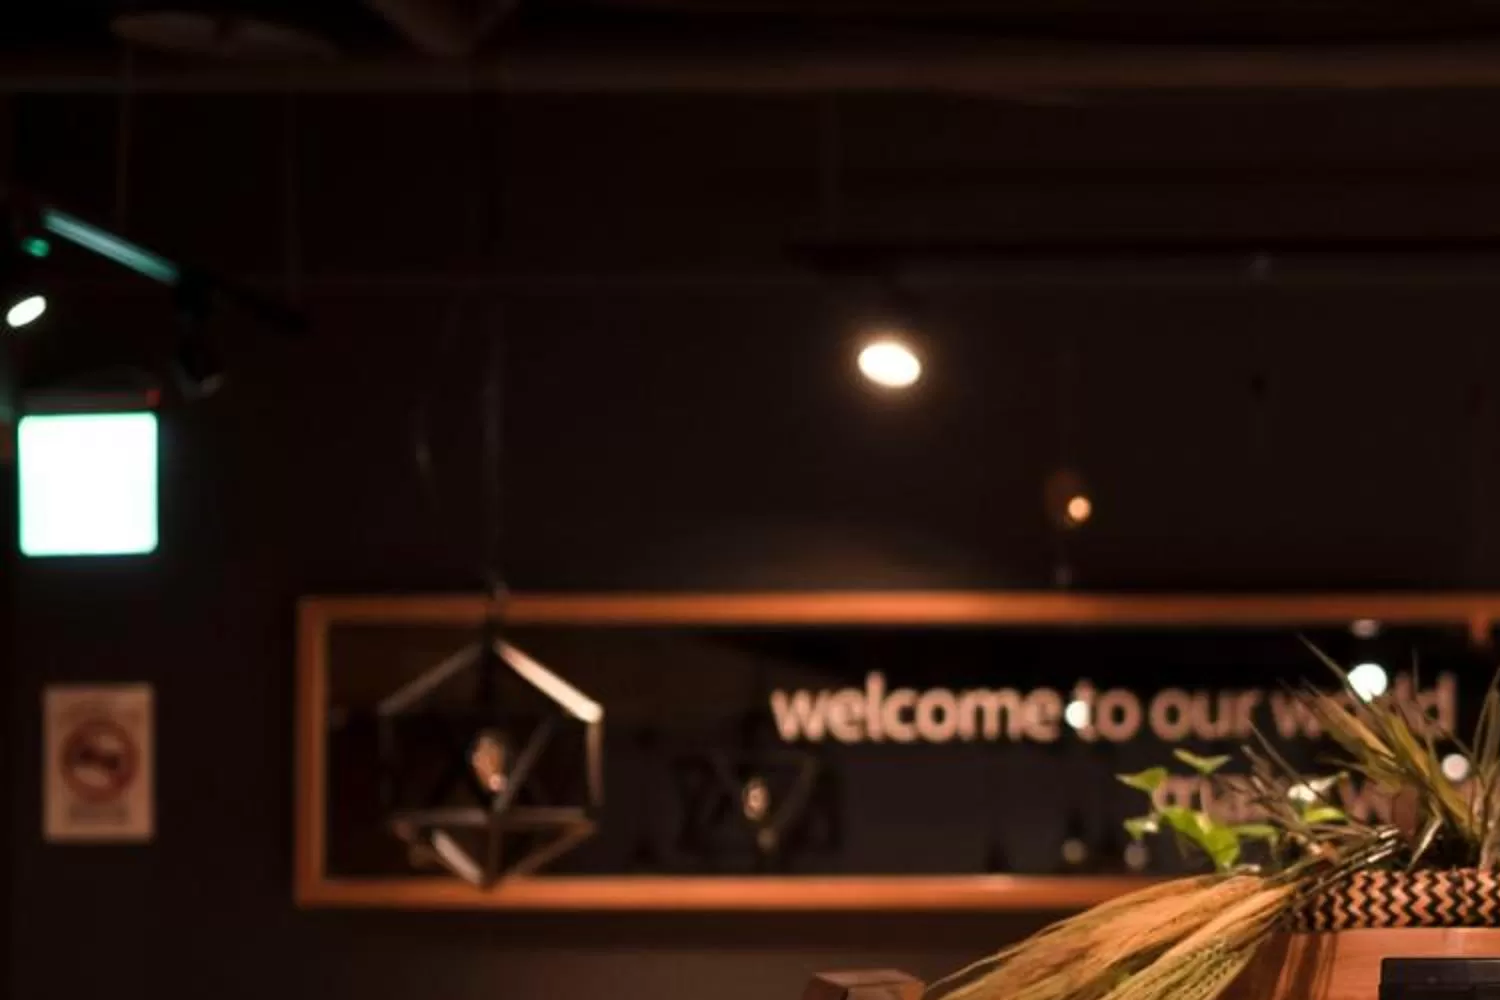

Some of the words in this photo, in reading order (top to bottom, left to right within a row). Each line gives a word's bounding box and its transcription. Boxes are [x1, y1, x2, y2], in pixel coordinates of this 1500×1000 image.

[771, 672, 1061, 742] welcome
[1066, 680, 1140, 742] to
[1150, 688, 1259, 742] our
[1270, 673, 1457, 741] wld
